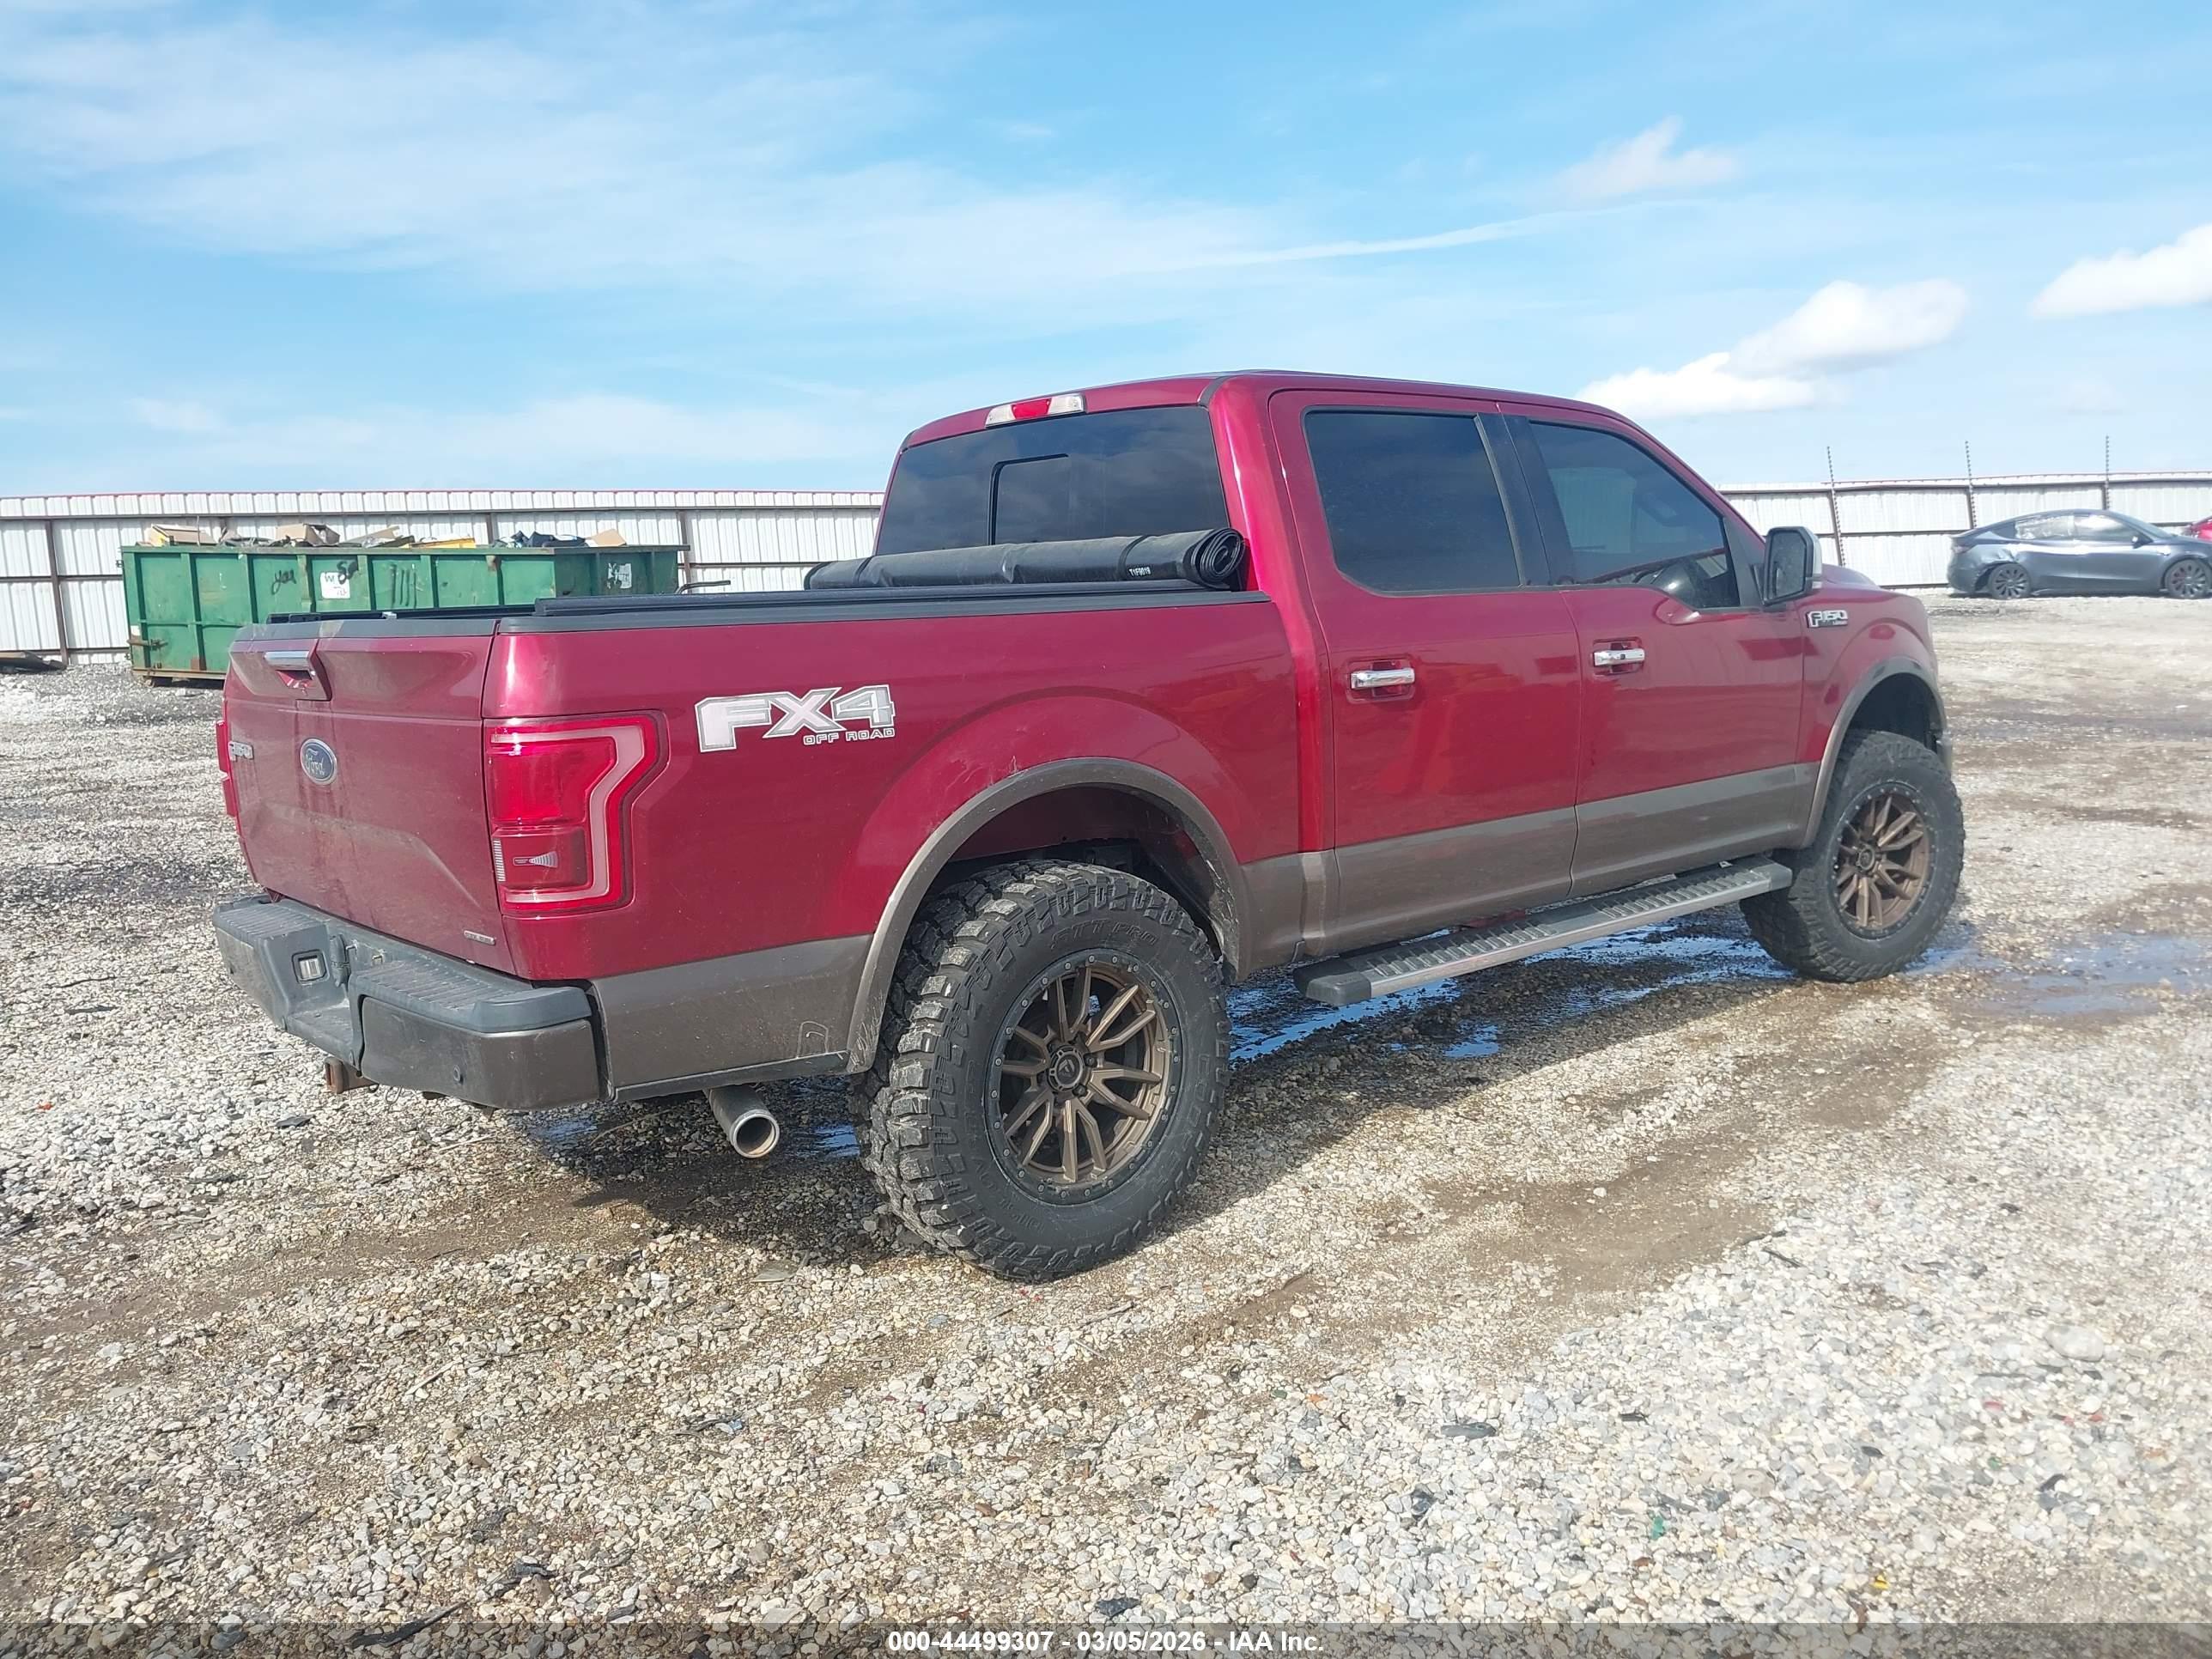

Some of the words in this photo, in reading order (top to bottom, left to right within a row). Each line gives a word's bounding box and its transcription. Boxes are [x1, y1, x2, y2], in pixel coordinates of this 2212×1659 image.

[695, 684, 895, 752] FX4
[803, 732, 840, 745] OFF
[845, 727, 895, 742] ROAD
[1112, 921, 1158, 945] PRO
